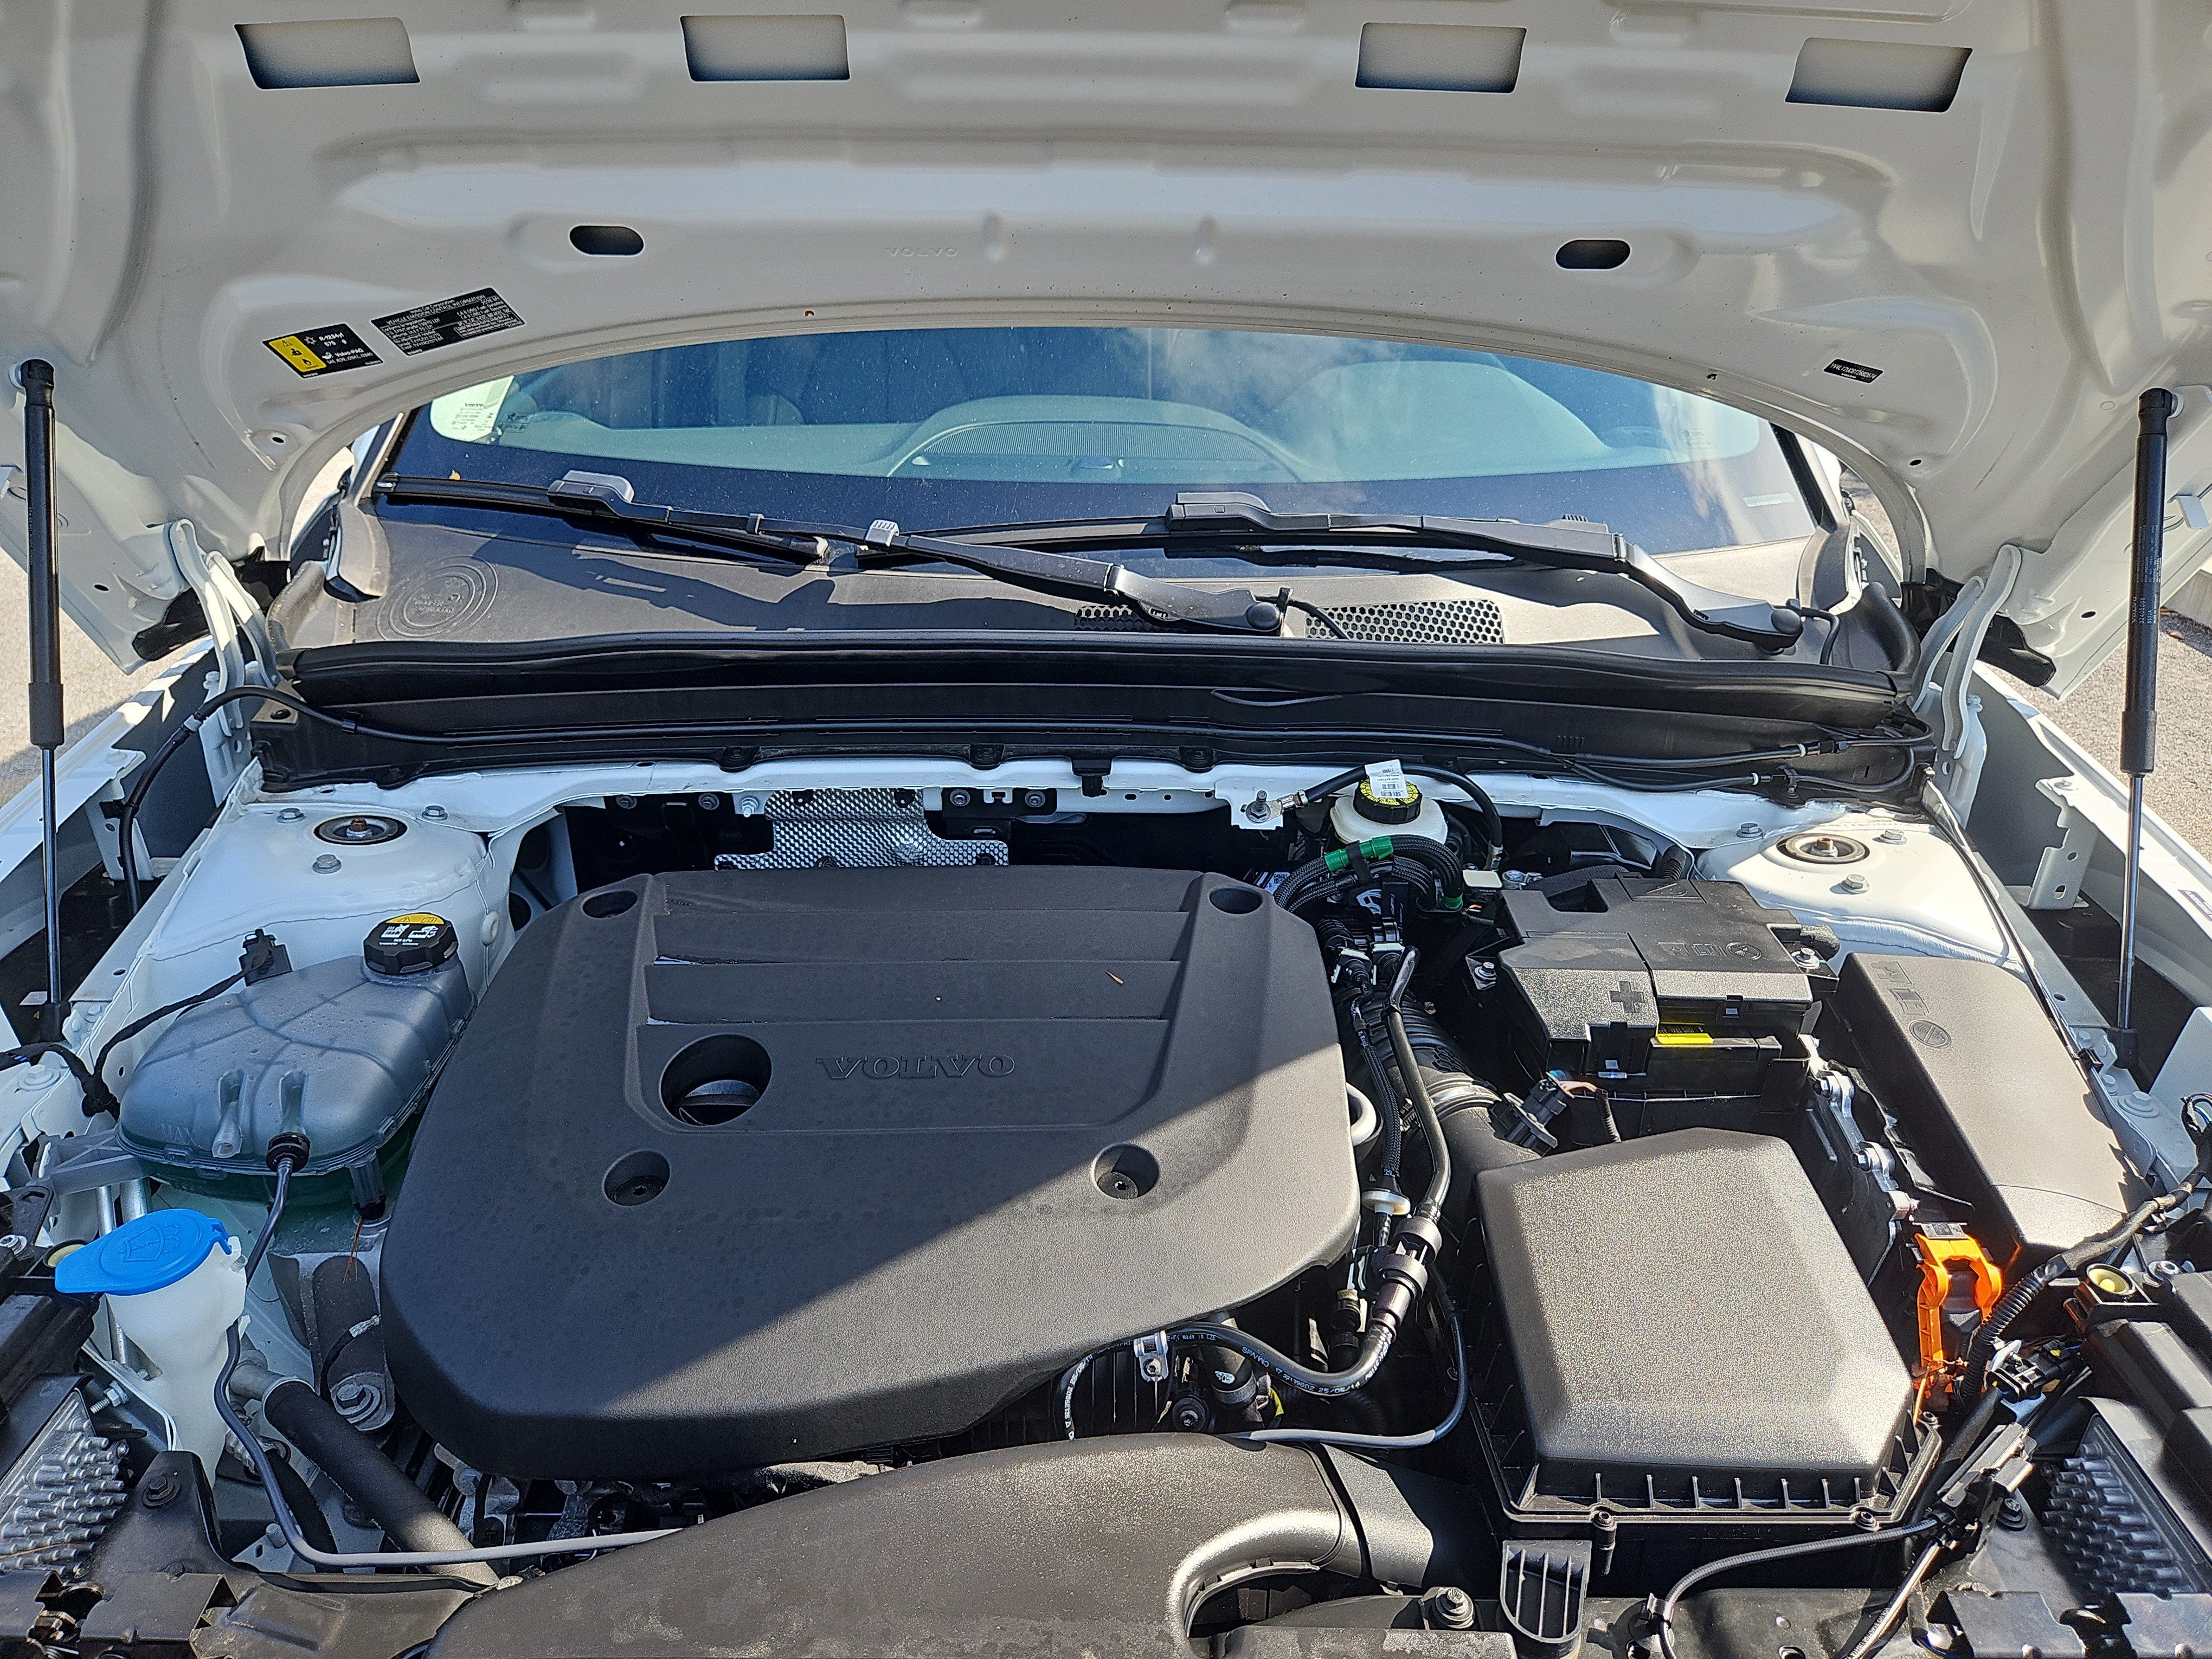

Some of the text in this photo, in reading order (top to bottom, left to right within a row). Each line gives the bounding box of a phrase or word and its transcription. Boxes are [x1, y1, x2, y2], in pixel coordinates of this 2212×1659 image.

[886, 247, 958, 256] VOLVO
[816, 1054, 1015, 1079] VOLVO
[1876, 1607, 1890, 1623] VOLVO
